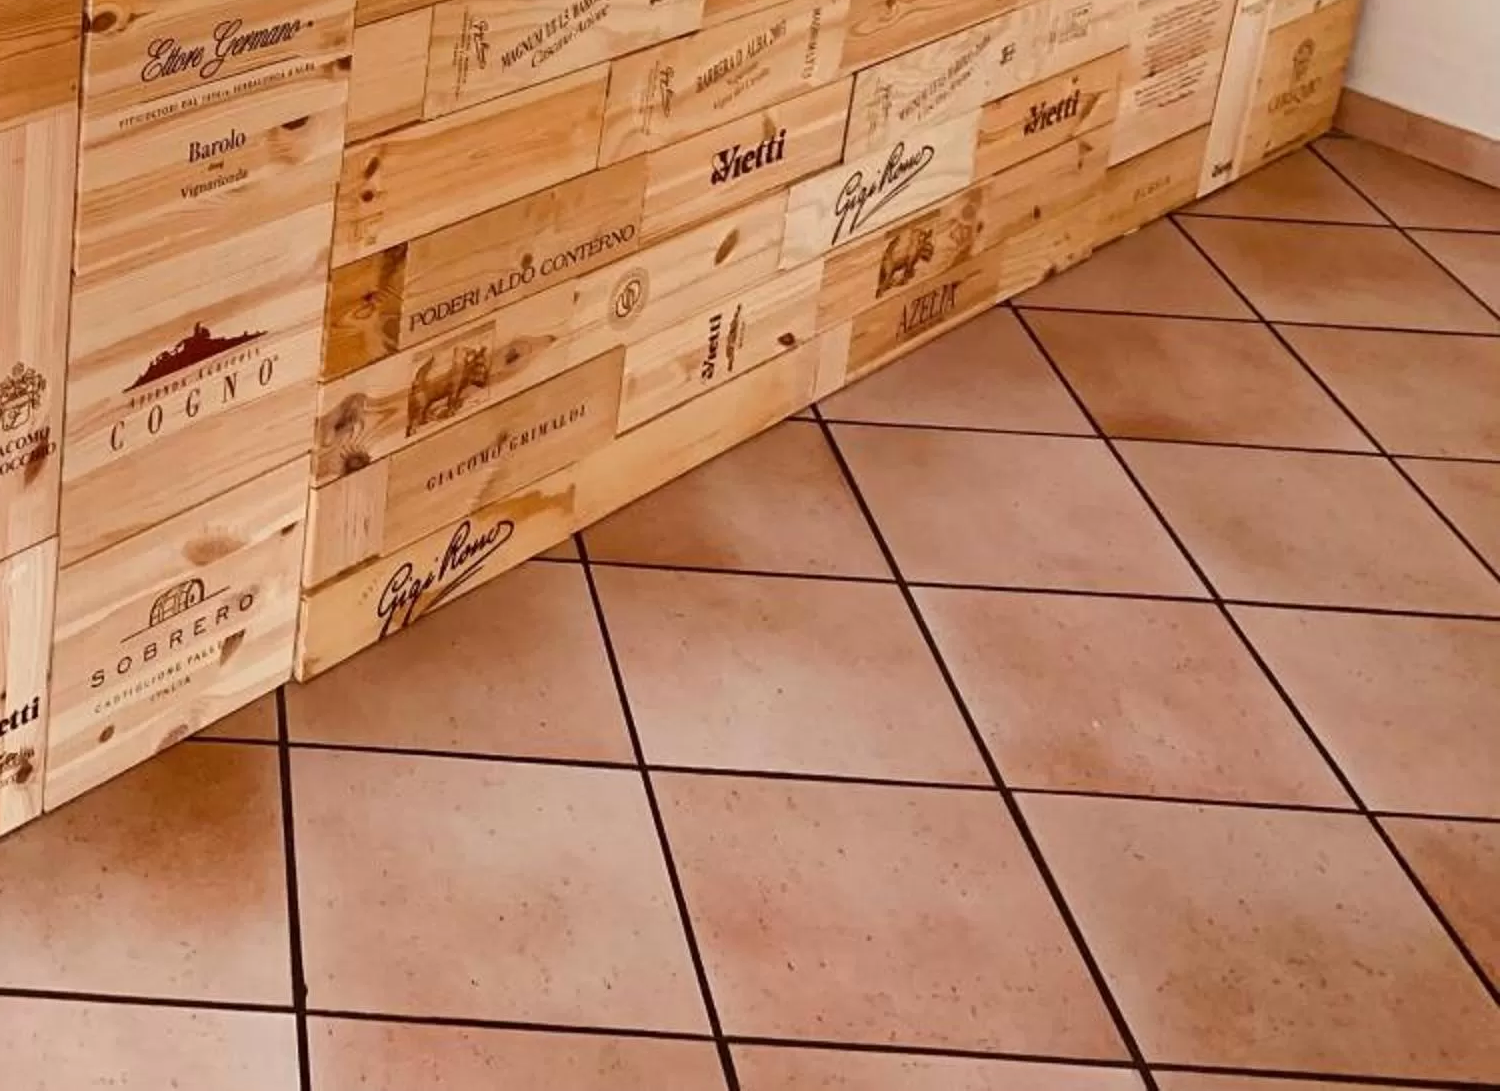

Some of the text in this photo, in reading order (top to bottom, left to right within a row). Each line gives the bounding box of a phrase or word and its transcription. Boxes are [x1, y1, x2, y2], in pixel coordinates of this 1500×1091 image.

[141, 37, 206, 83] Ettore
[1023, 83, 1080, 137] Vietti
[189, 128, 247, 164] Barolo
[710, 128, 787, 186] Vietti
[408, 224, 636, 333] PODERI ALDO CONTERNO
[109, 357, 275, 452] COGNO
[426, 404, 587, 492] GIACOMO GRIMALDI
[89, 593, 254, 689] SOBRERO
[94, 662, 182, 715] CASTIGLIONE
